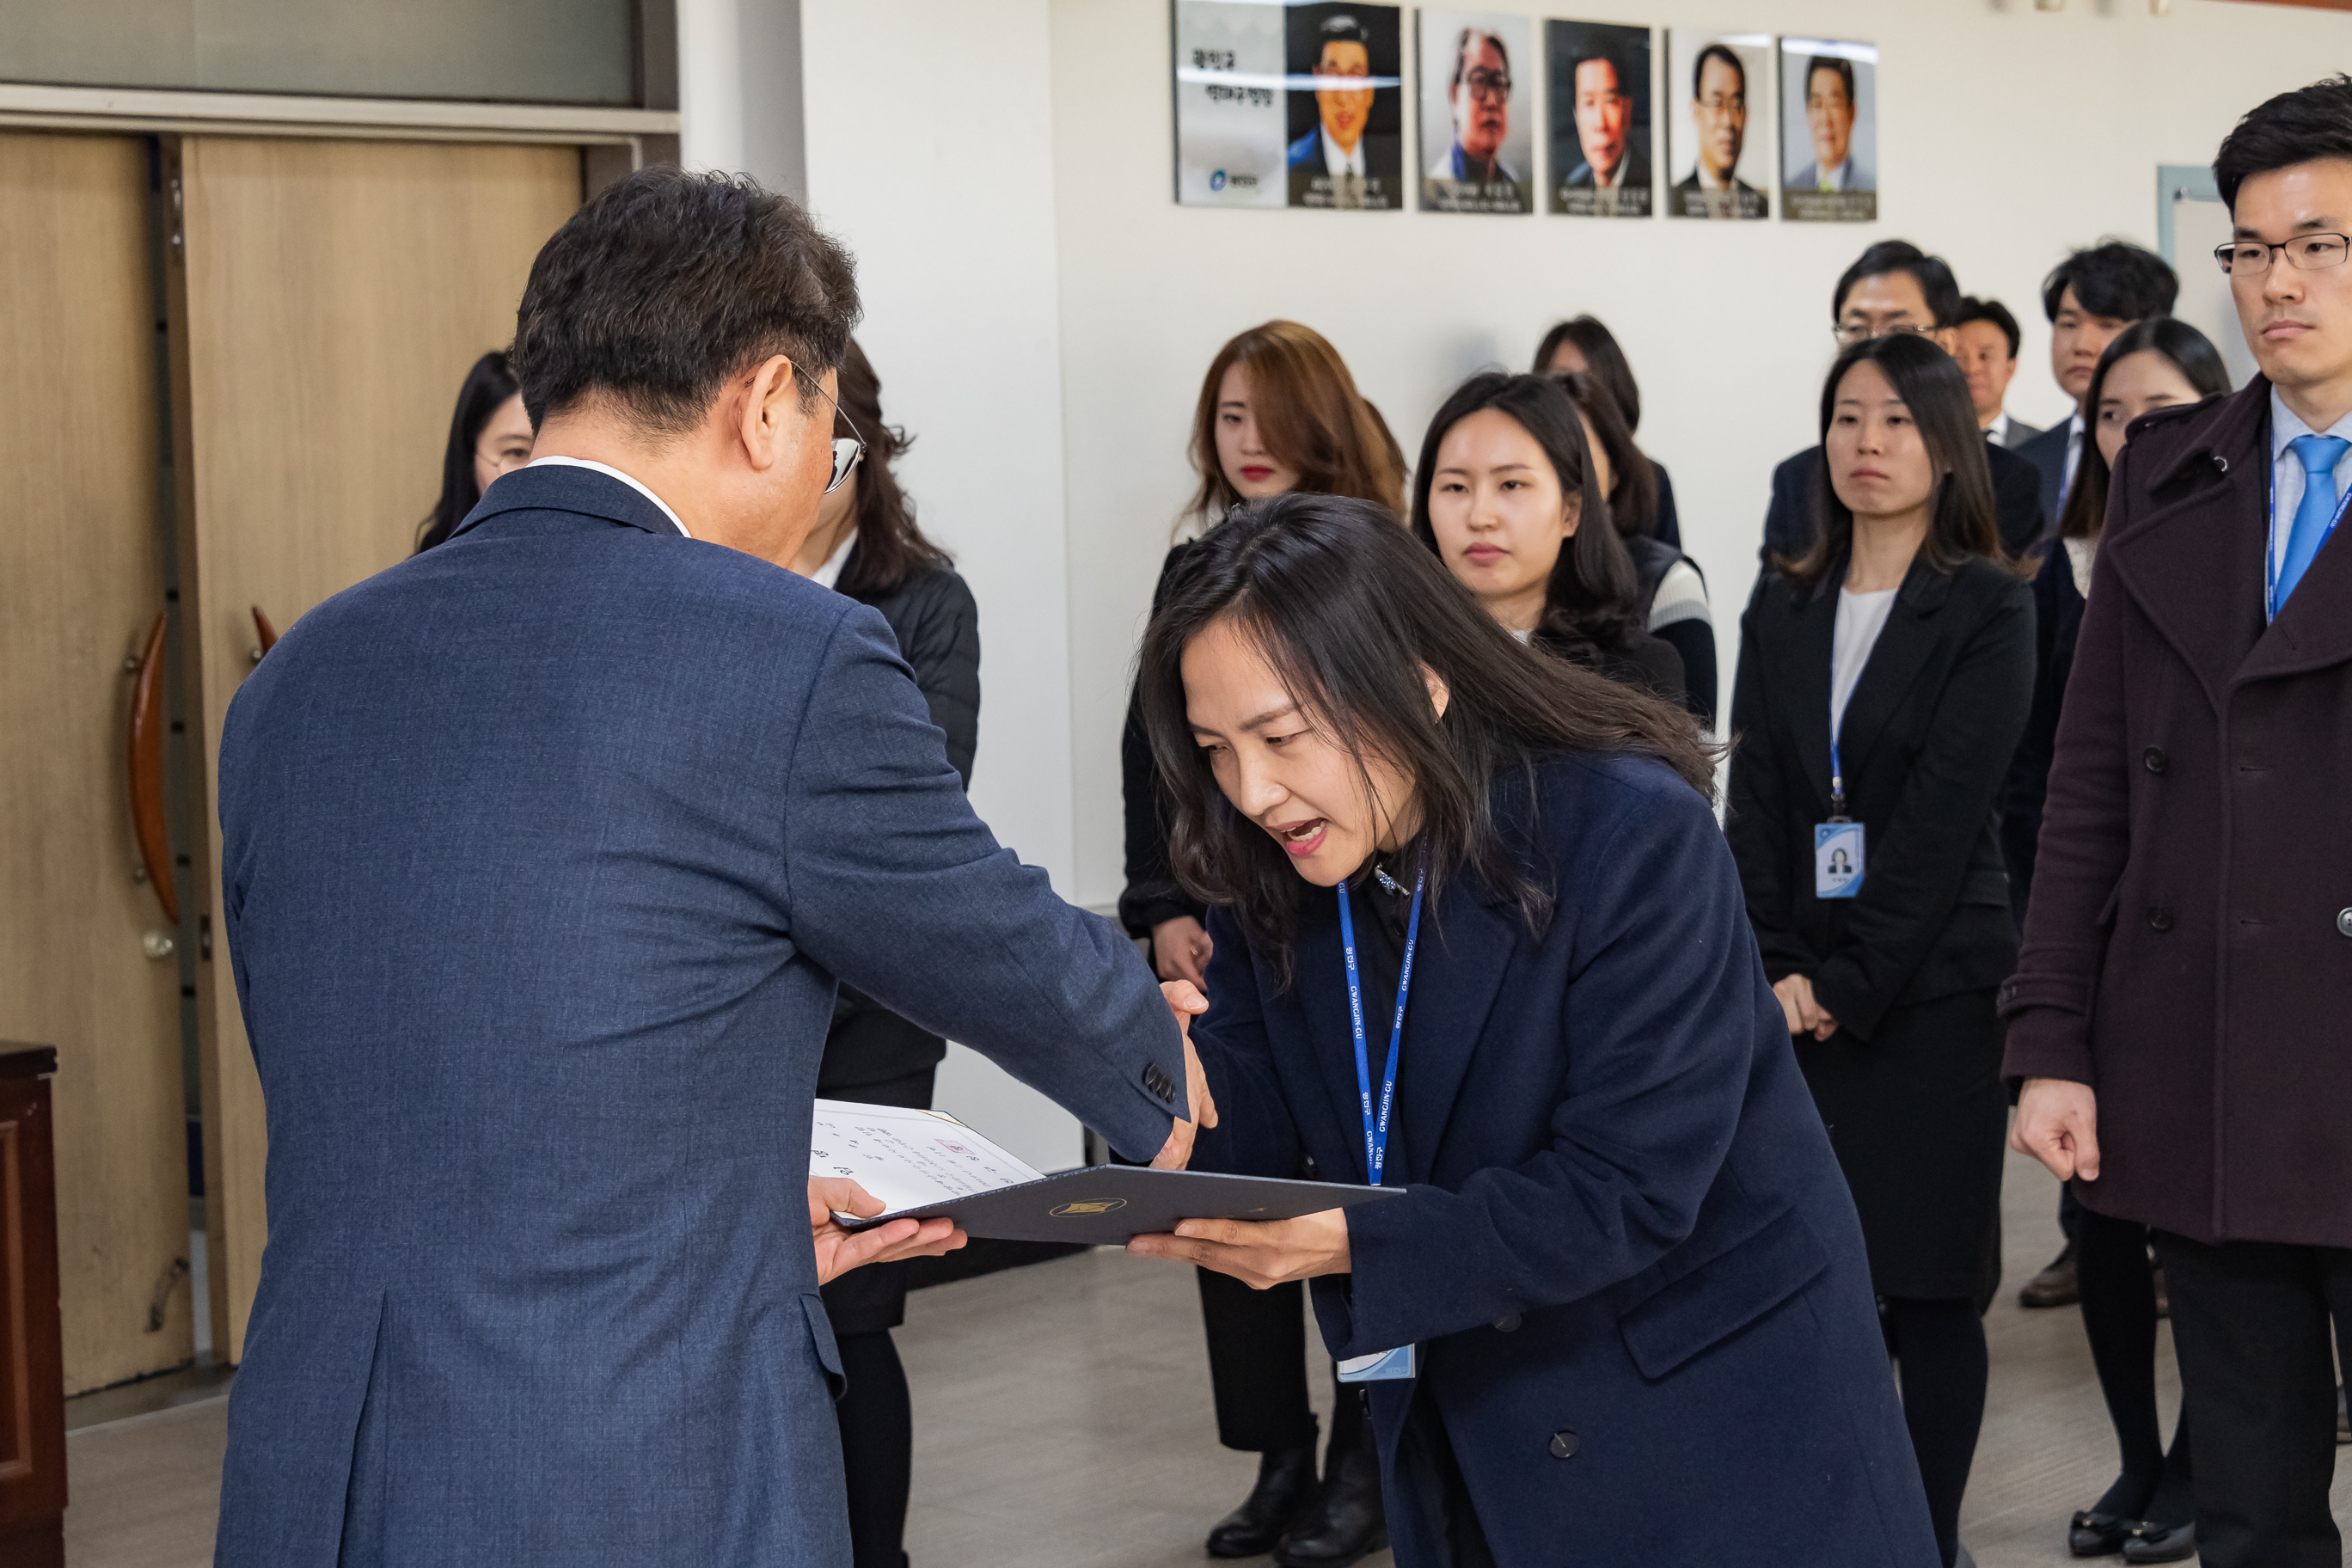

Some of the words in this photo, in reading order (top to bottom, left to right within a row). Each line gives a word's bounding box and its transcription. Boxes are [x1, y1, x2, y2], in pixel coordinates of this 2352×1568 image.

[1345, 946, 1355, 971] 광진구
[1362, 1092, 1371, 1116] 광진구
[1375, 1145, 1383, 1170] 광진구
